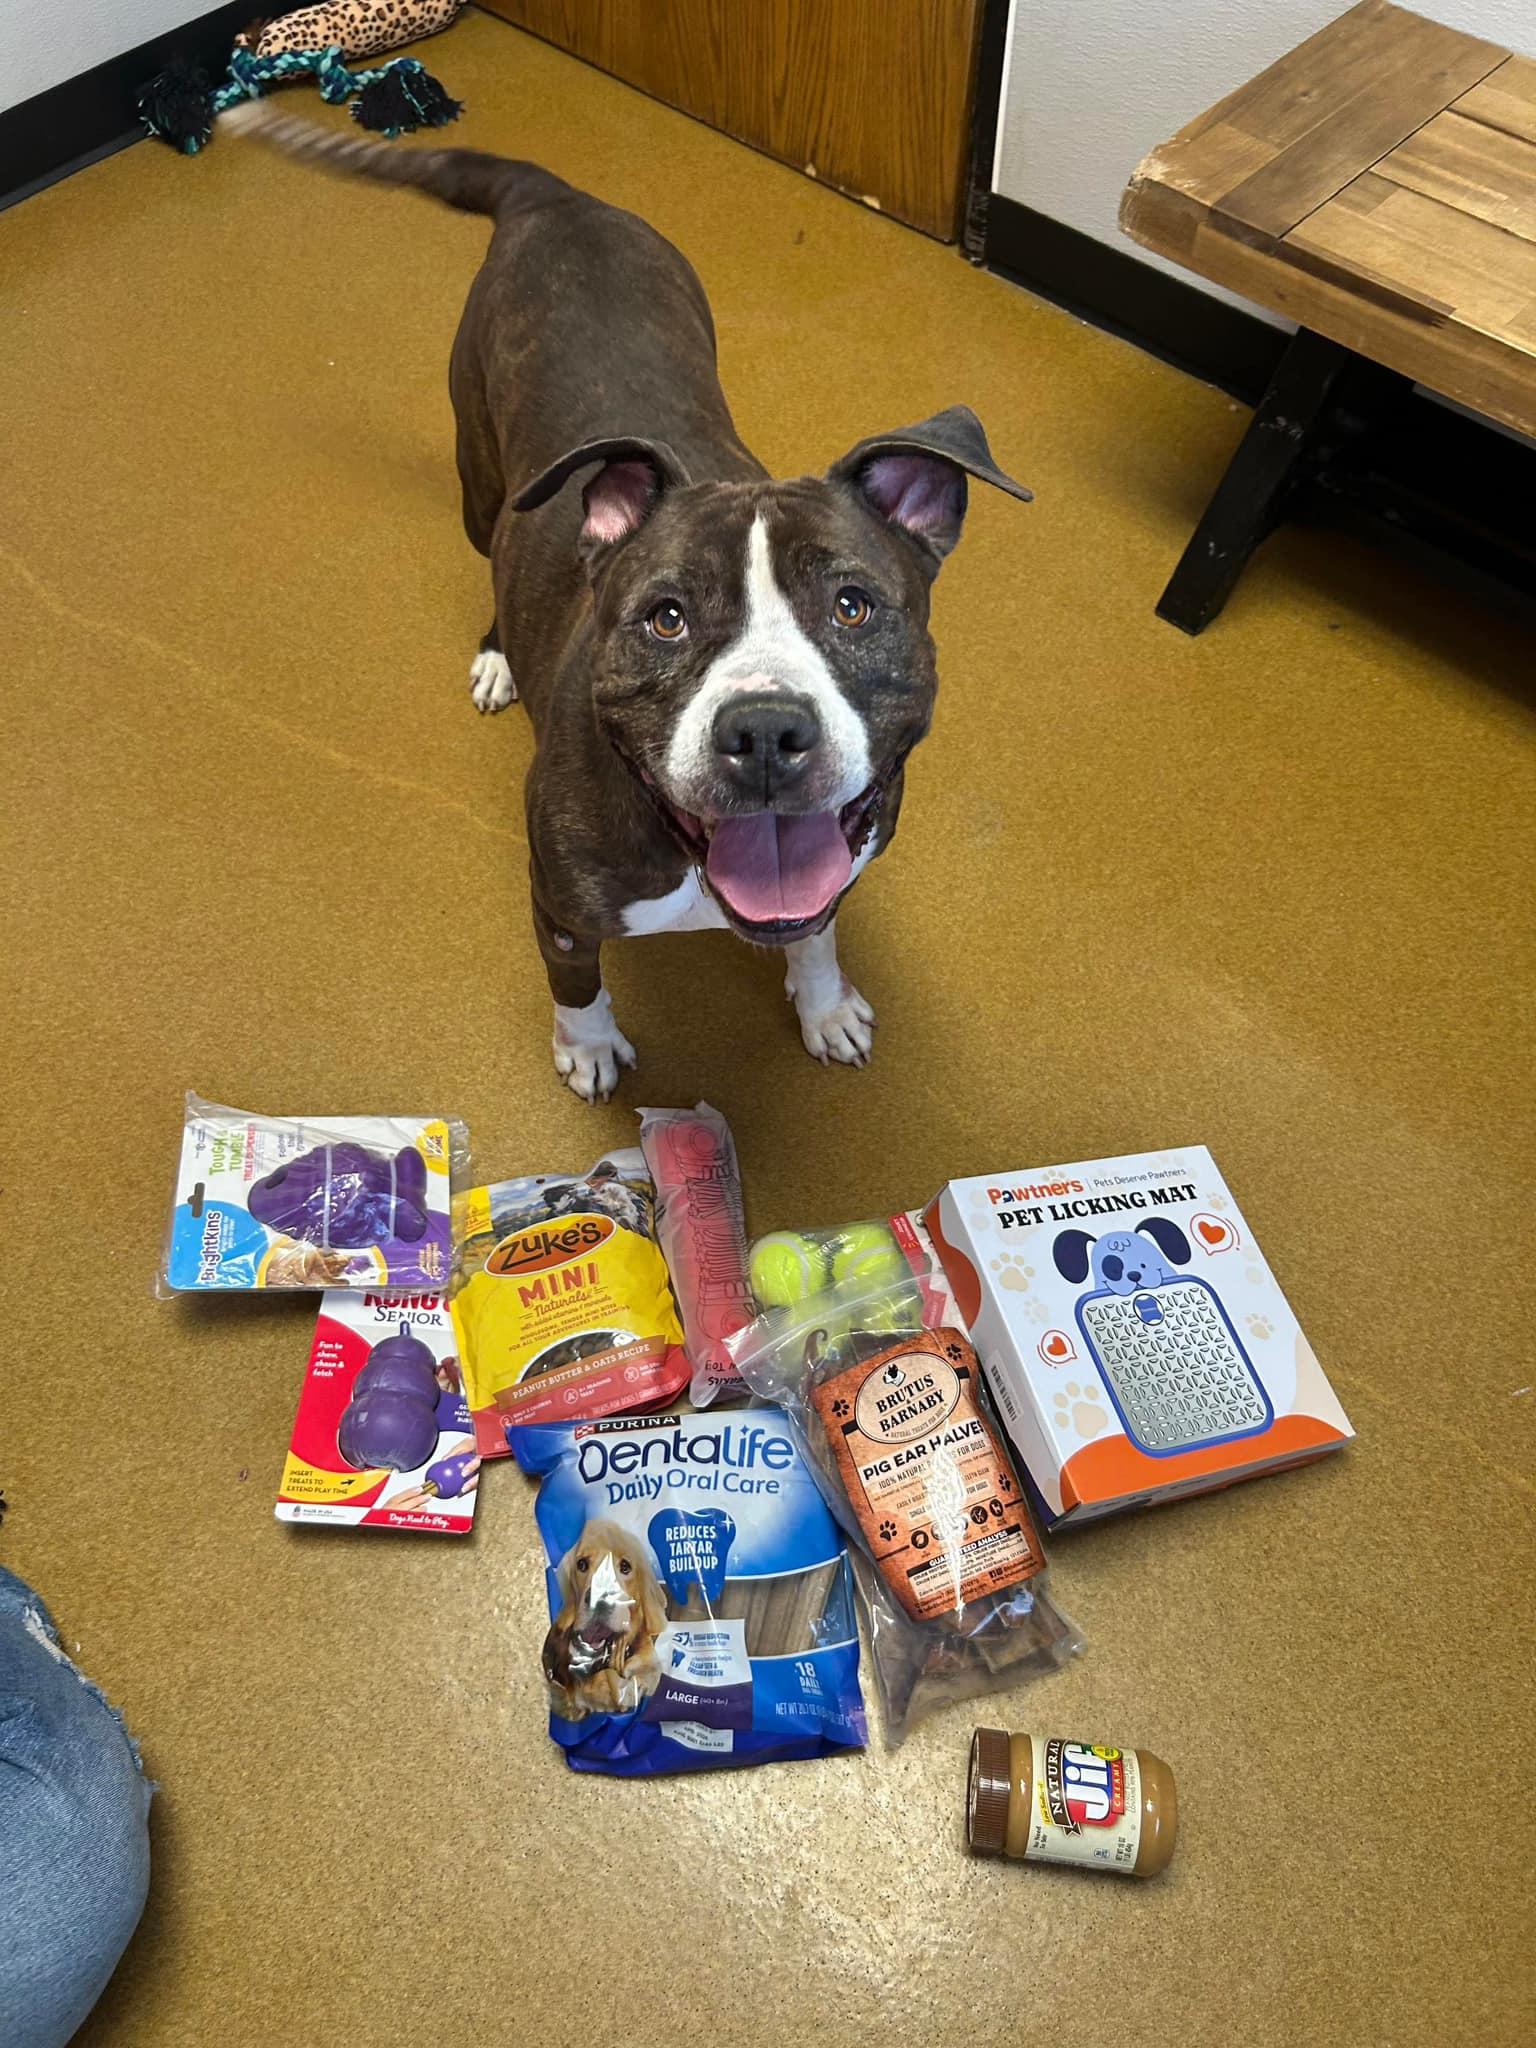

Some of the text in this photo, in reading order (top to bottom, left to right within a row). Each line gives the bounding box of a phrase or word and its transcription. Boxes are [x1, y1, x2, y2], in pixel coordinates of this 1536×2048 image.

[209, 1137, 228, 1175] TOUGH
[230, 1133, 244, 1171] TUMBLE
[987, 1167, 1187, 1204] Pawtners Pets Deserve Pawtners
[997, 1183, 1199, 1229] PET LICKING MAT
[201, 1212, 221, 1281] Brightkins
[517, 1262, 600, 1309] MINI
[534, 1291, 588, 1317] Naturals
[512, 1343, 650, 1399] PEANUT BUTTER & OATS RECIPE
[875, 1373, 934, 1414] BRUTUS
[878, 1389, 944, 1433] BARNABY
[599, 1416, 677, 1431] PURINA
[863, 1460, 892, 1480] PIG
[893, 1443, 928, 1468] EAR
[878, 1439, 986, 1489] 100% NATURAL FOR DOGS
[286, 1485, 314, 1493] EXTEND
[314, 1486, 332, 1494] PLAY
[289, 1477, 313, 1485] TREATS
[605, 1468, 780, 1505] Daily Oral Care
[665, 1525, 717, 1542] REDUCES
[669, 1540, 713, 1557] TARTAR
[669, 1555, 719, 1574] BUILDUP
[795, 1661, 816, 1678] 18
[665, 1690, 700, 1705] LARGE
[1048, 1741, 1063, 1815] NATURAL
[1064, 1743, 1109, 1820] Jif
[1111, 1760, 1122, 1807] CREAMY
